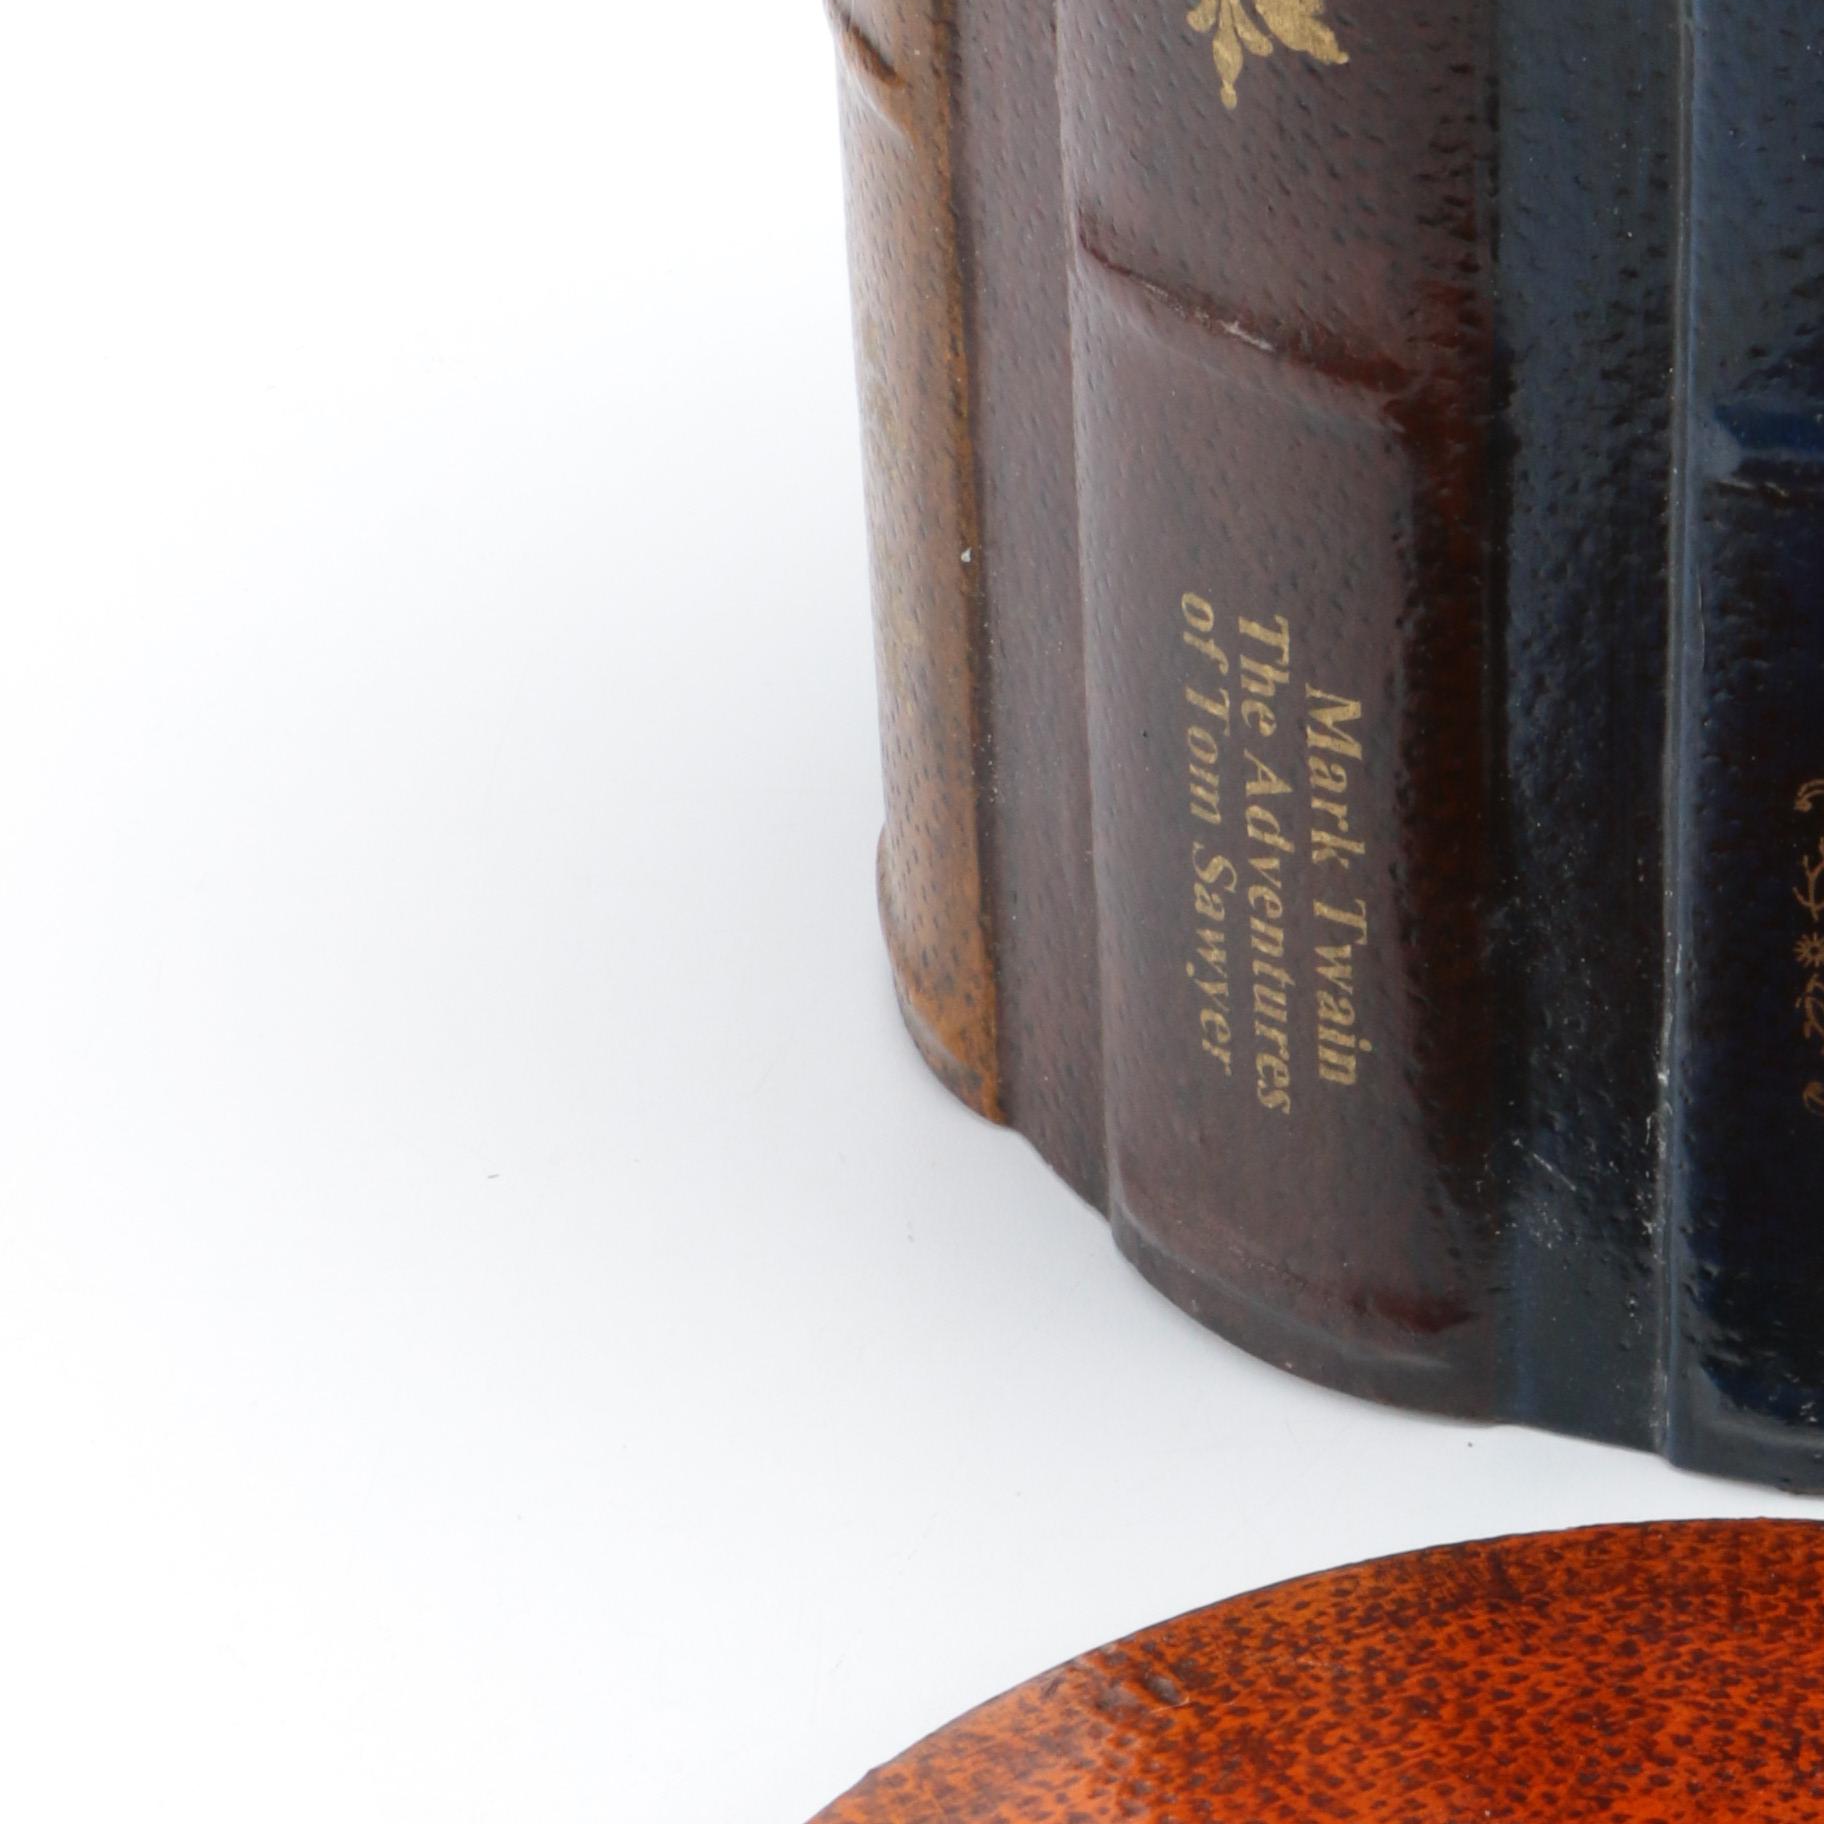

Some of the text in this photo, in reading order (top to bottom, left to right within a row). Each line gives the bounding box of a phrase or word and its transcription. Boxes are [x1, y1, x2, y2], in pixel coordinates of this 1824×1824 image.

[1181, 591, 1238, 1076] of Tom Sawyer
[1238, 615, 1295, 1115] The Adventures
[1305, 683, 1373, 1087] Mark Twain
